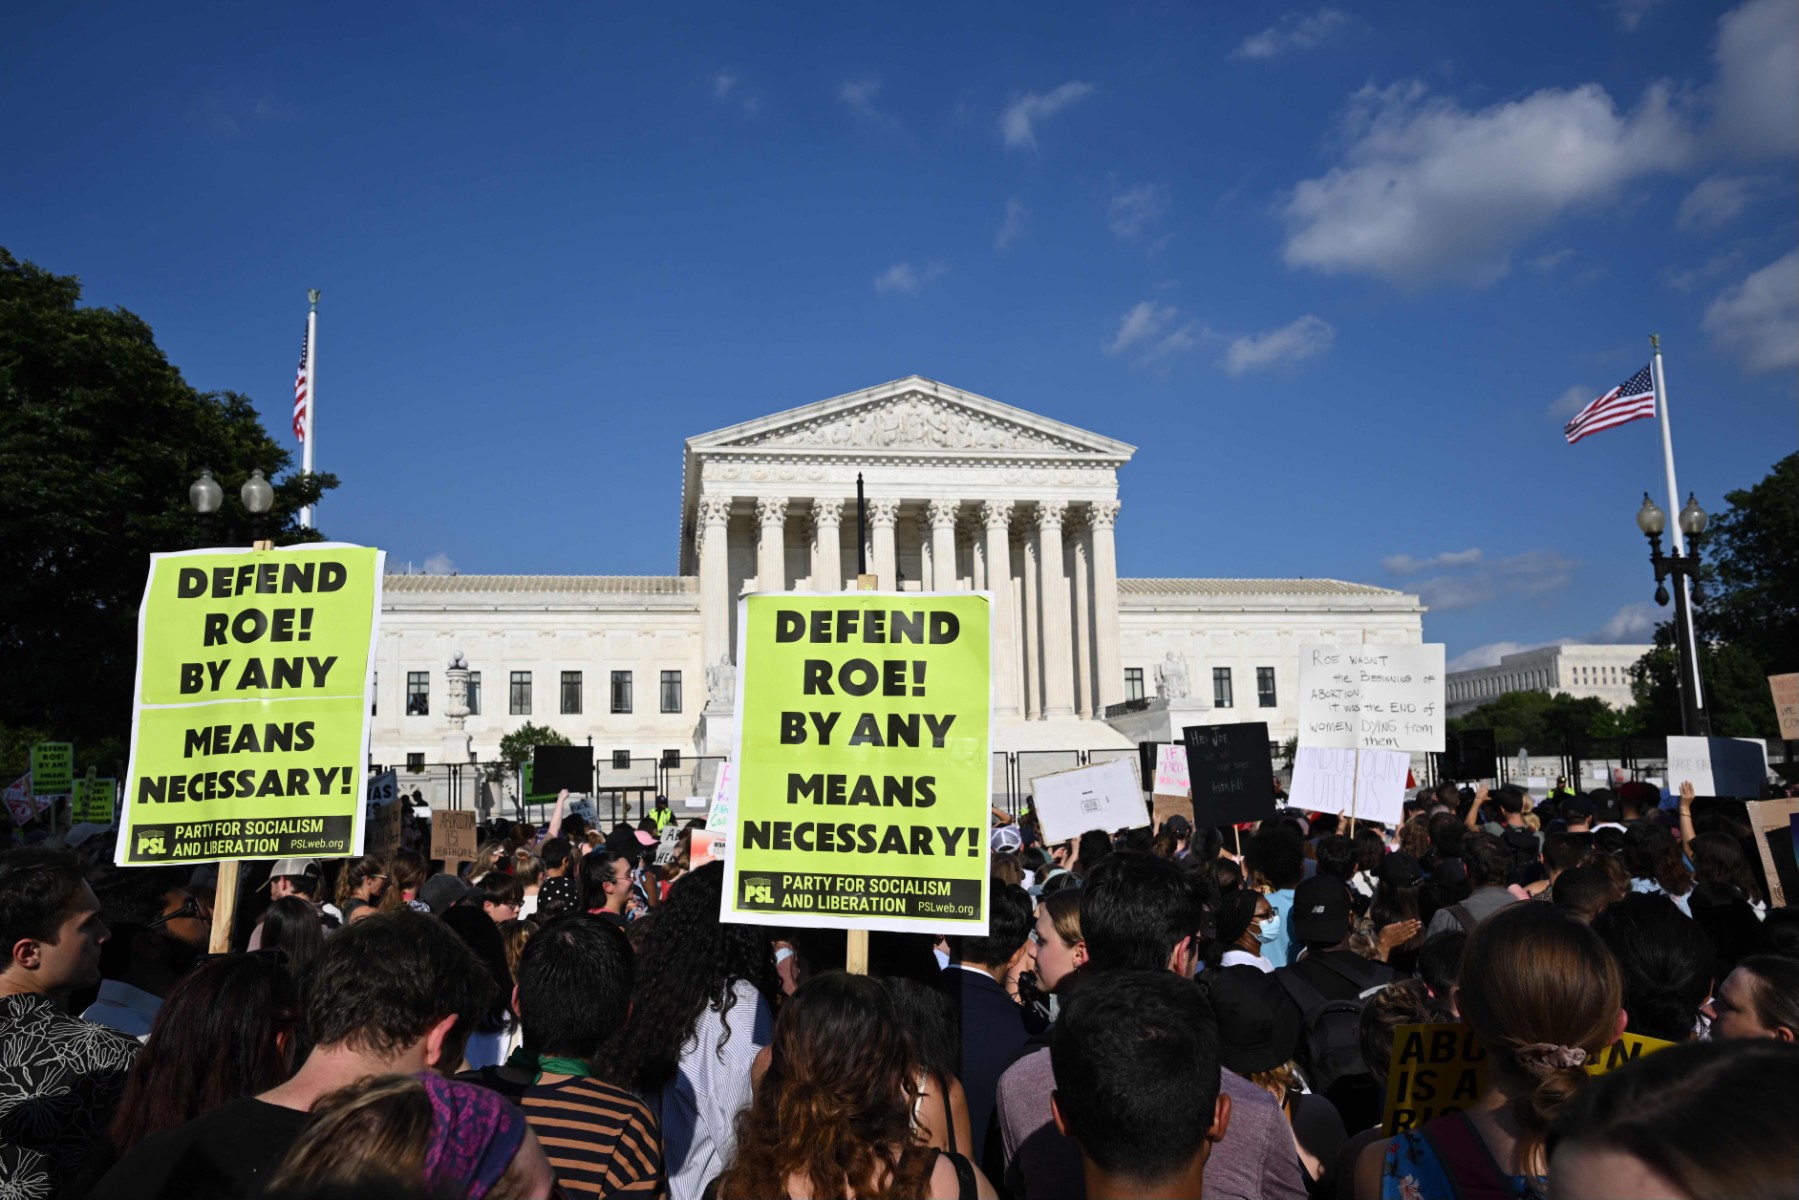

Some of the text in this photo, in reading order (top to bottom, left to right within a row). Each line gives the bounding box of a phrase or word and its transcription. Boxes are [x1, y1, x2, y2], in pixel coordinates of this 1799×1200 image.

[177, 562, 347, 598] DEFEND
[203, 608, 314, 647] ROE!
[775, 610, 960, 645] DEFEND
[1312, 649, 1341, 666] ROE
[180, 656, 338, 694] BY ANY
[803, 658, 927, 697] ROE!
[1390, 702, 1416, 713] END
[780, 711, 957, 748] BY ANY
[1309, 718, 1433, 735] WOMEN DYING from
[184, 721, 315, 758] MEANS
[1363, 737, 1400, 748] them
[137, 766, 353, 804] NECESSARY!
[787, 773, 937, 808] MEANS
[175, 819, 324, 839] PARTY FOR SOCIALISM
[742, 820, 980, 857] NECESSARY!
[137, 837, 167, 855] PSL
[172, 839, 279, 857] AND LIBERATION
[290, 839, 344, 850] PSLweb.org
[744, 885, 775, 904] PSL
[782, 875, 951, 896] PARTY FOR SOCIALISM
[781, 894, 906, 913] AND LIBERATION
[918, 901, 974, 915] PSLweb.org
[1311, 905, 1325, 914] NB
[1397, 1068, 1479, 1103] IS A
